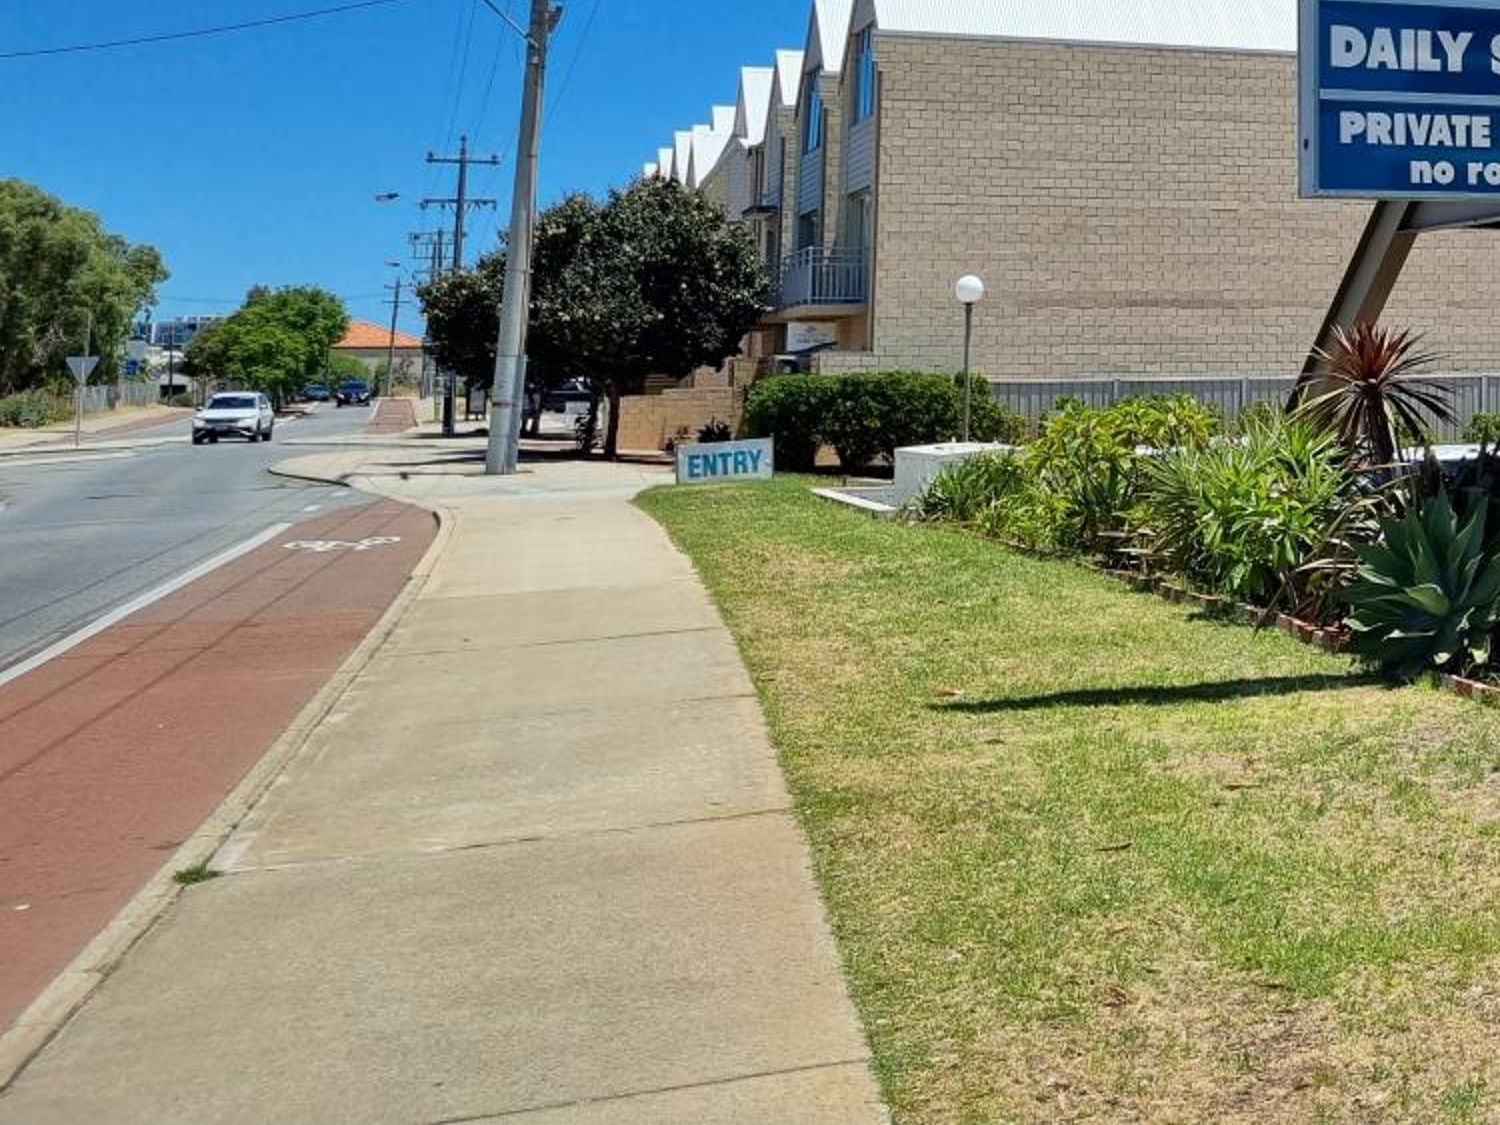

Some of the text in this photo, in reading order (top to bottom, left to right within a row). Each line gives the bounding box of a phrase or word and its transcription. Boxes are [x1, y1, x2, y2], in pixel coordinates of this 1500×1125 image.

[1331, 25, 1473, 72] DAILY
[1339, 111, 1491, 148] PRIVATE
[1410, 160, 1455, 185] no
[688, 449, 762, 478] ENTRY
